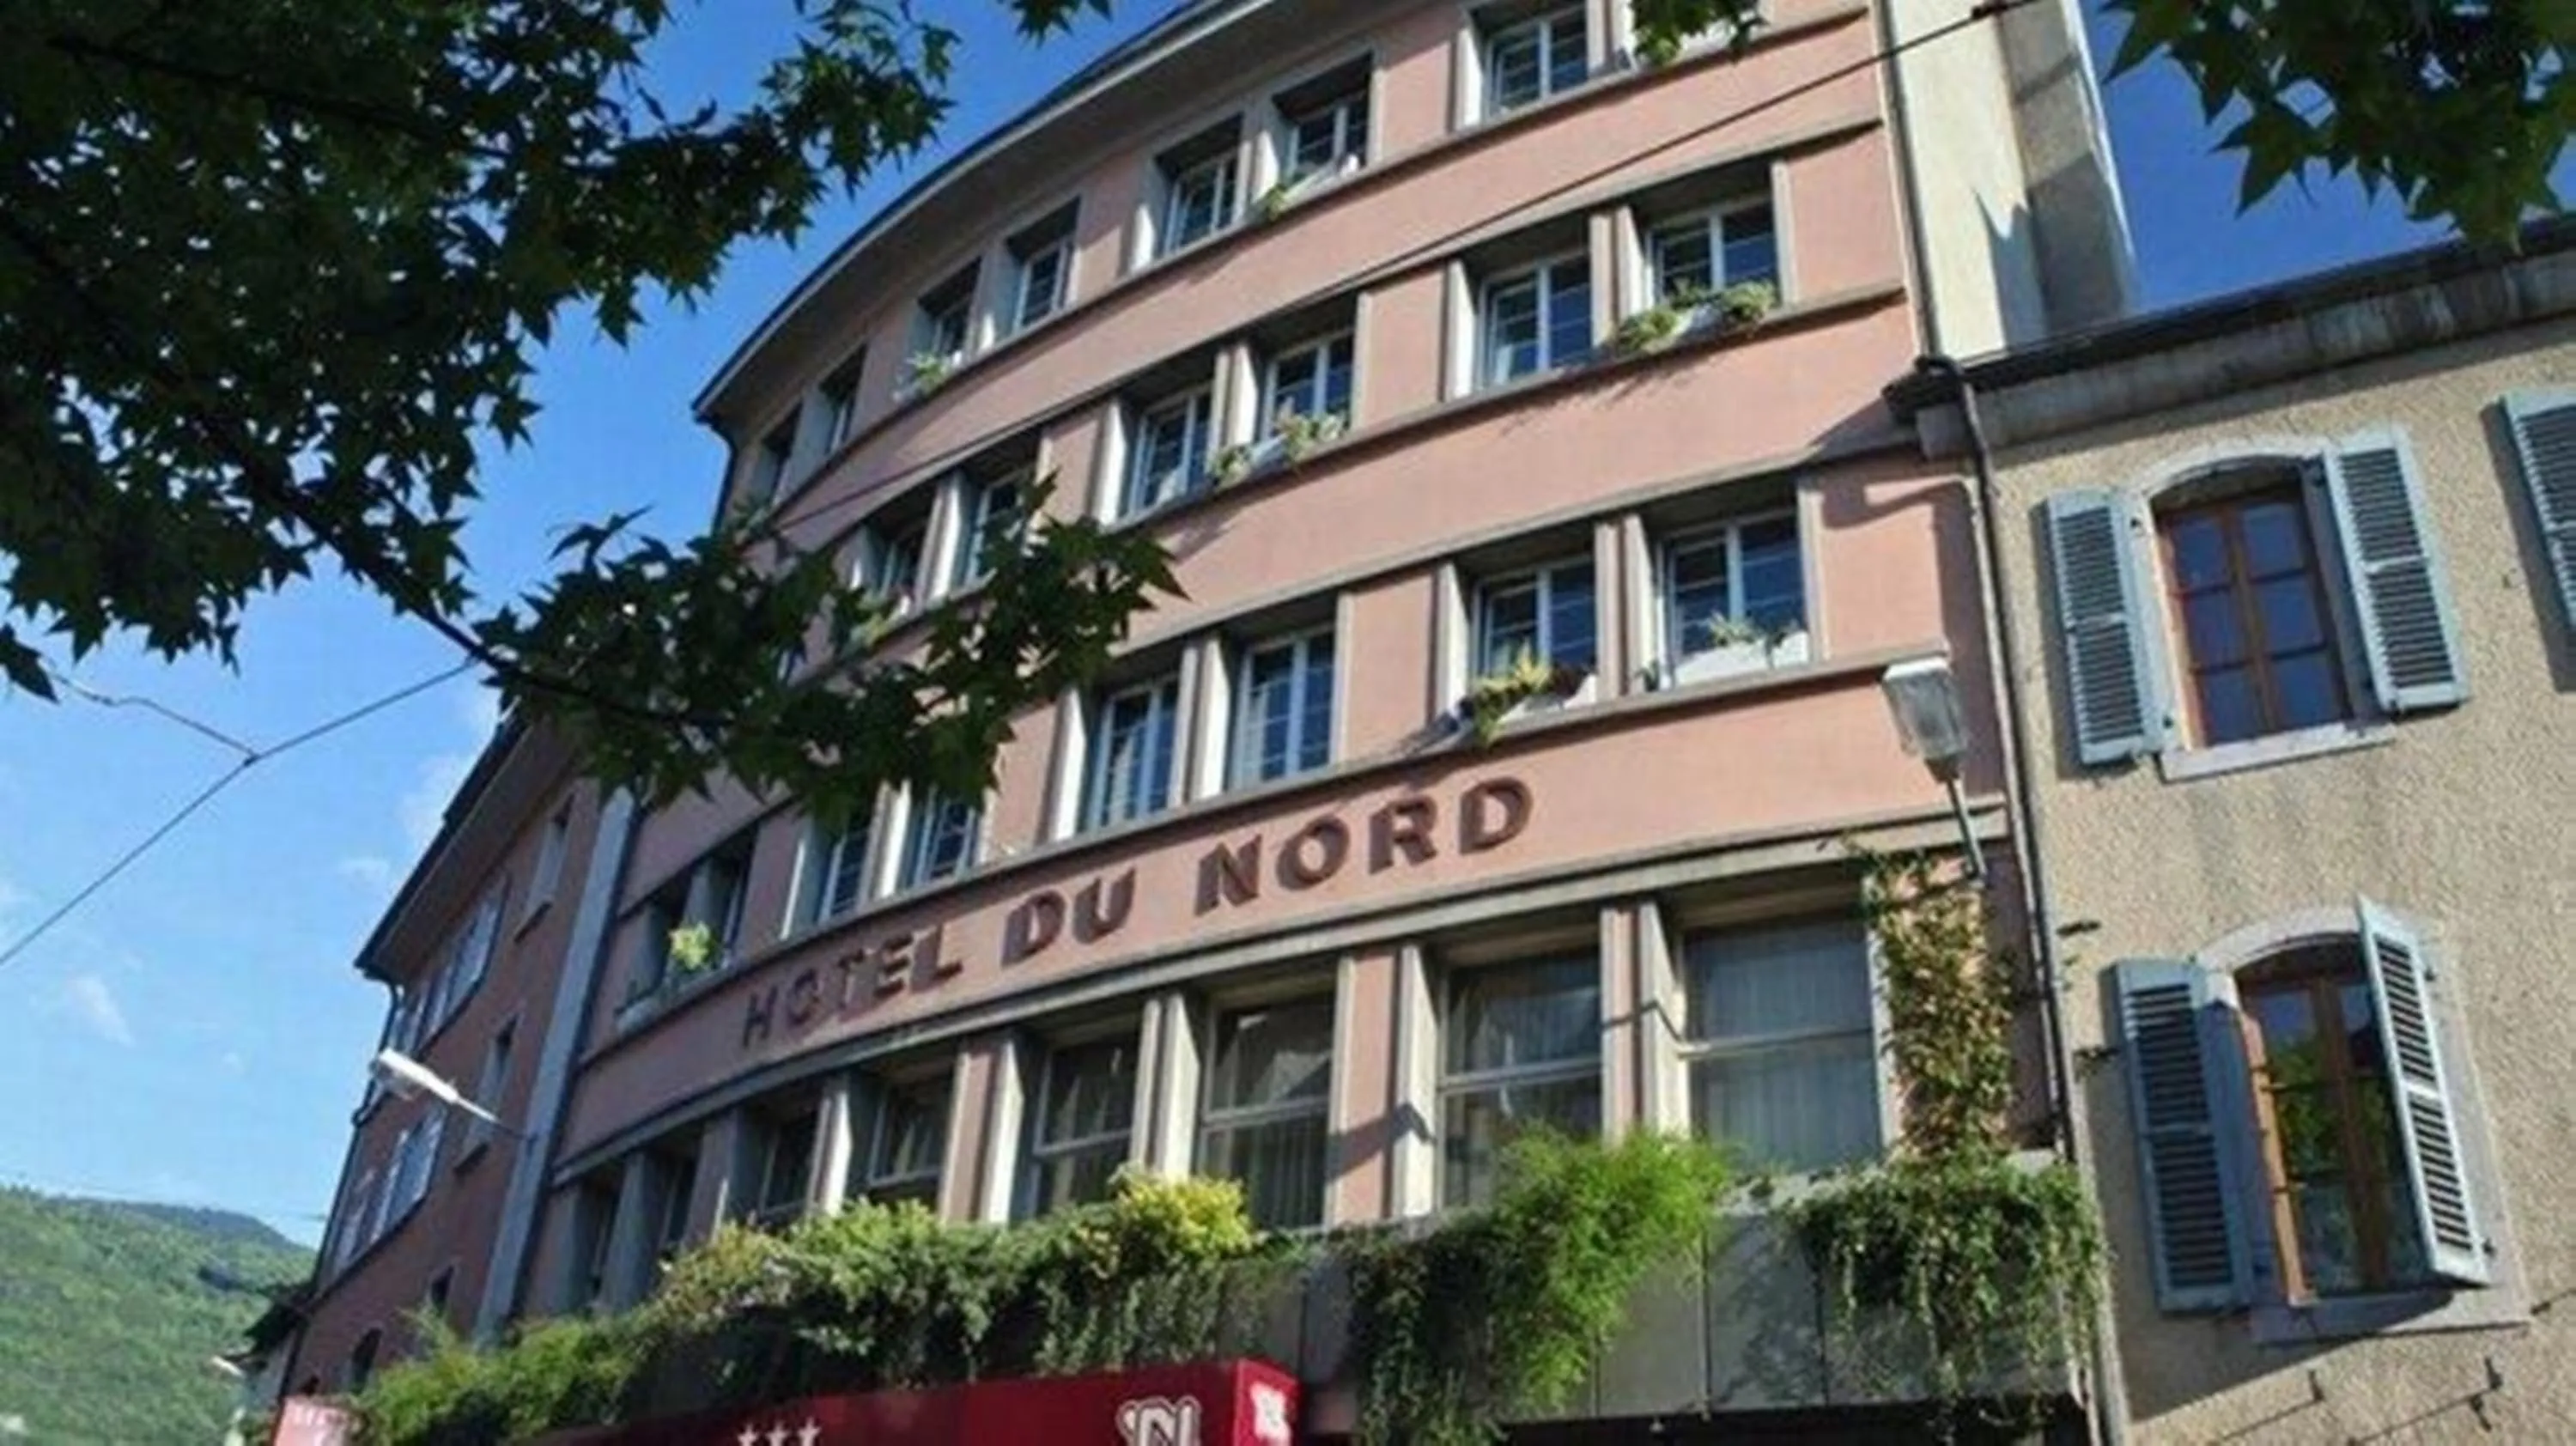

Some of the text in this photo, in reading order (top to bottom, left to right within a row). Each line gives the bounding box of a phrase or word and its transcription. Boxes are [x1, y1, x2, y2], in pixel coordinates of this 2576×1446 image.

[744, 776, 1534, 1048] HOTEL DU NORD
